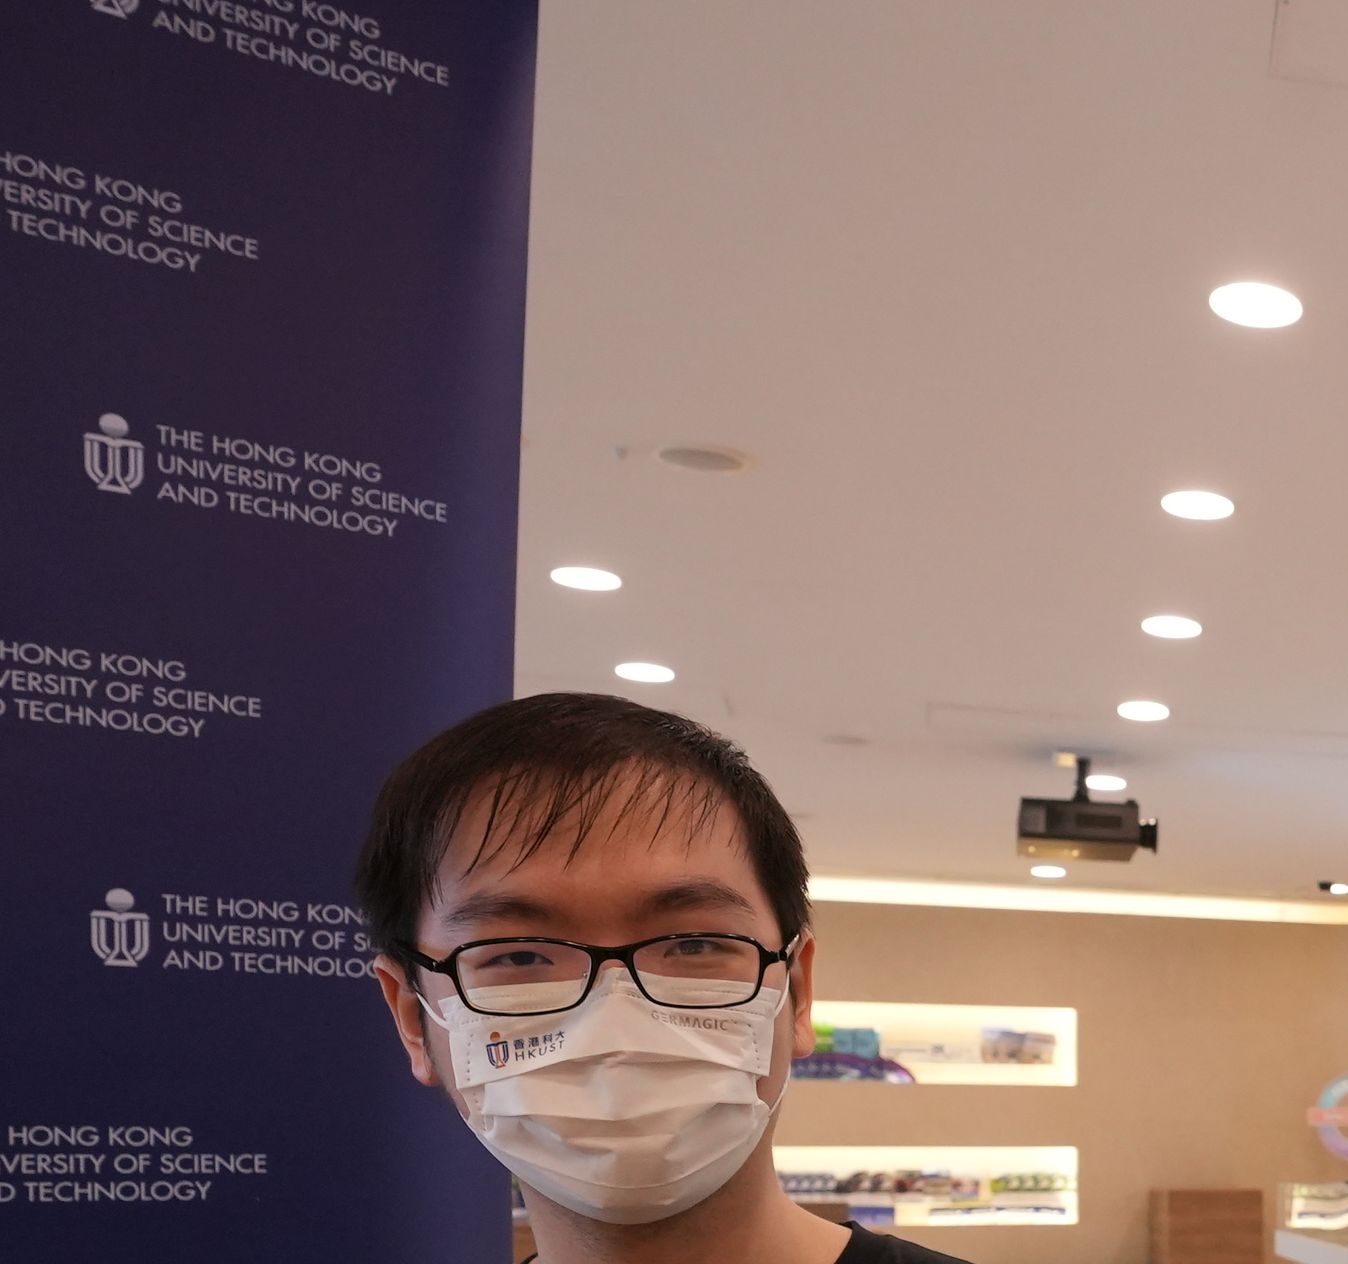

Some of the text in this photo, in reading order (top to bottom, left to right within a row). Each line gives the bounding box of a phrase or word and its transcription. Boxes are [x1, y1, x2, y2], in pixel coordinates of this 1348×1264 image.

[302, 1, 381, 39] KONG
[152, 10, 398, 96] AND TECHNOLOGY
[158, 0, 449, 87] IVERSITY OF SCIENCE
[95, 174, 183, 213] KONG
[0, 178, 259, 260] ERSITY OF SCIENCE
[6, 208, 201, 272] TECHNOLOGY
[156, 424, 382, 483] THE HONG KONG
[157, 452, 448, 523] UNIVERSITY OF SCIENCE
[157, 482, 397, 537] AND TECHNOLOGY
[0, 640, 186, 682] HONG KONG
[0, 670, 262, 718] VERSITY OF SCIENCE
[13, 699, 205, 738] TECHNOLOGY
[161, 894, 366, 926] THE HONG KON
[162, 922, 305, 948] UNIVERSITY
[312, 930, 346, 950] OF
[162, 950, 378, 978] AND TECHNOLO
[513, 1030, 565, 1050] 香港科大
[515, 1040, 565, 1061] HKUST
[8, 1125, 194, 1147] HONG KONG
[0, 1153, 268, 1174] VERSITY OF SCIENCE
[24, 1180, 212, 1202] TECHNOLOGY
